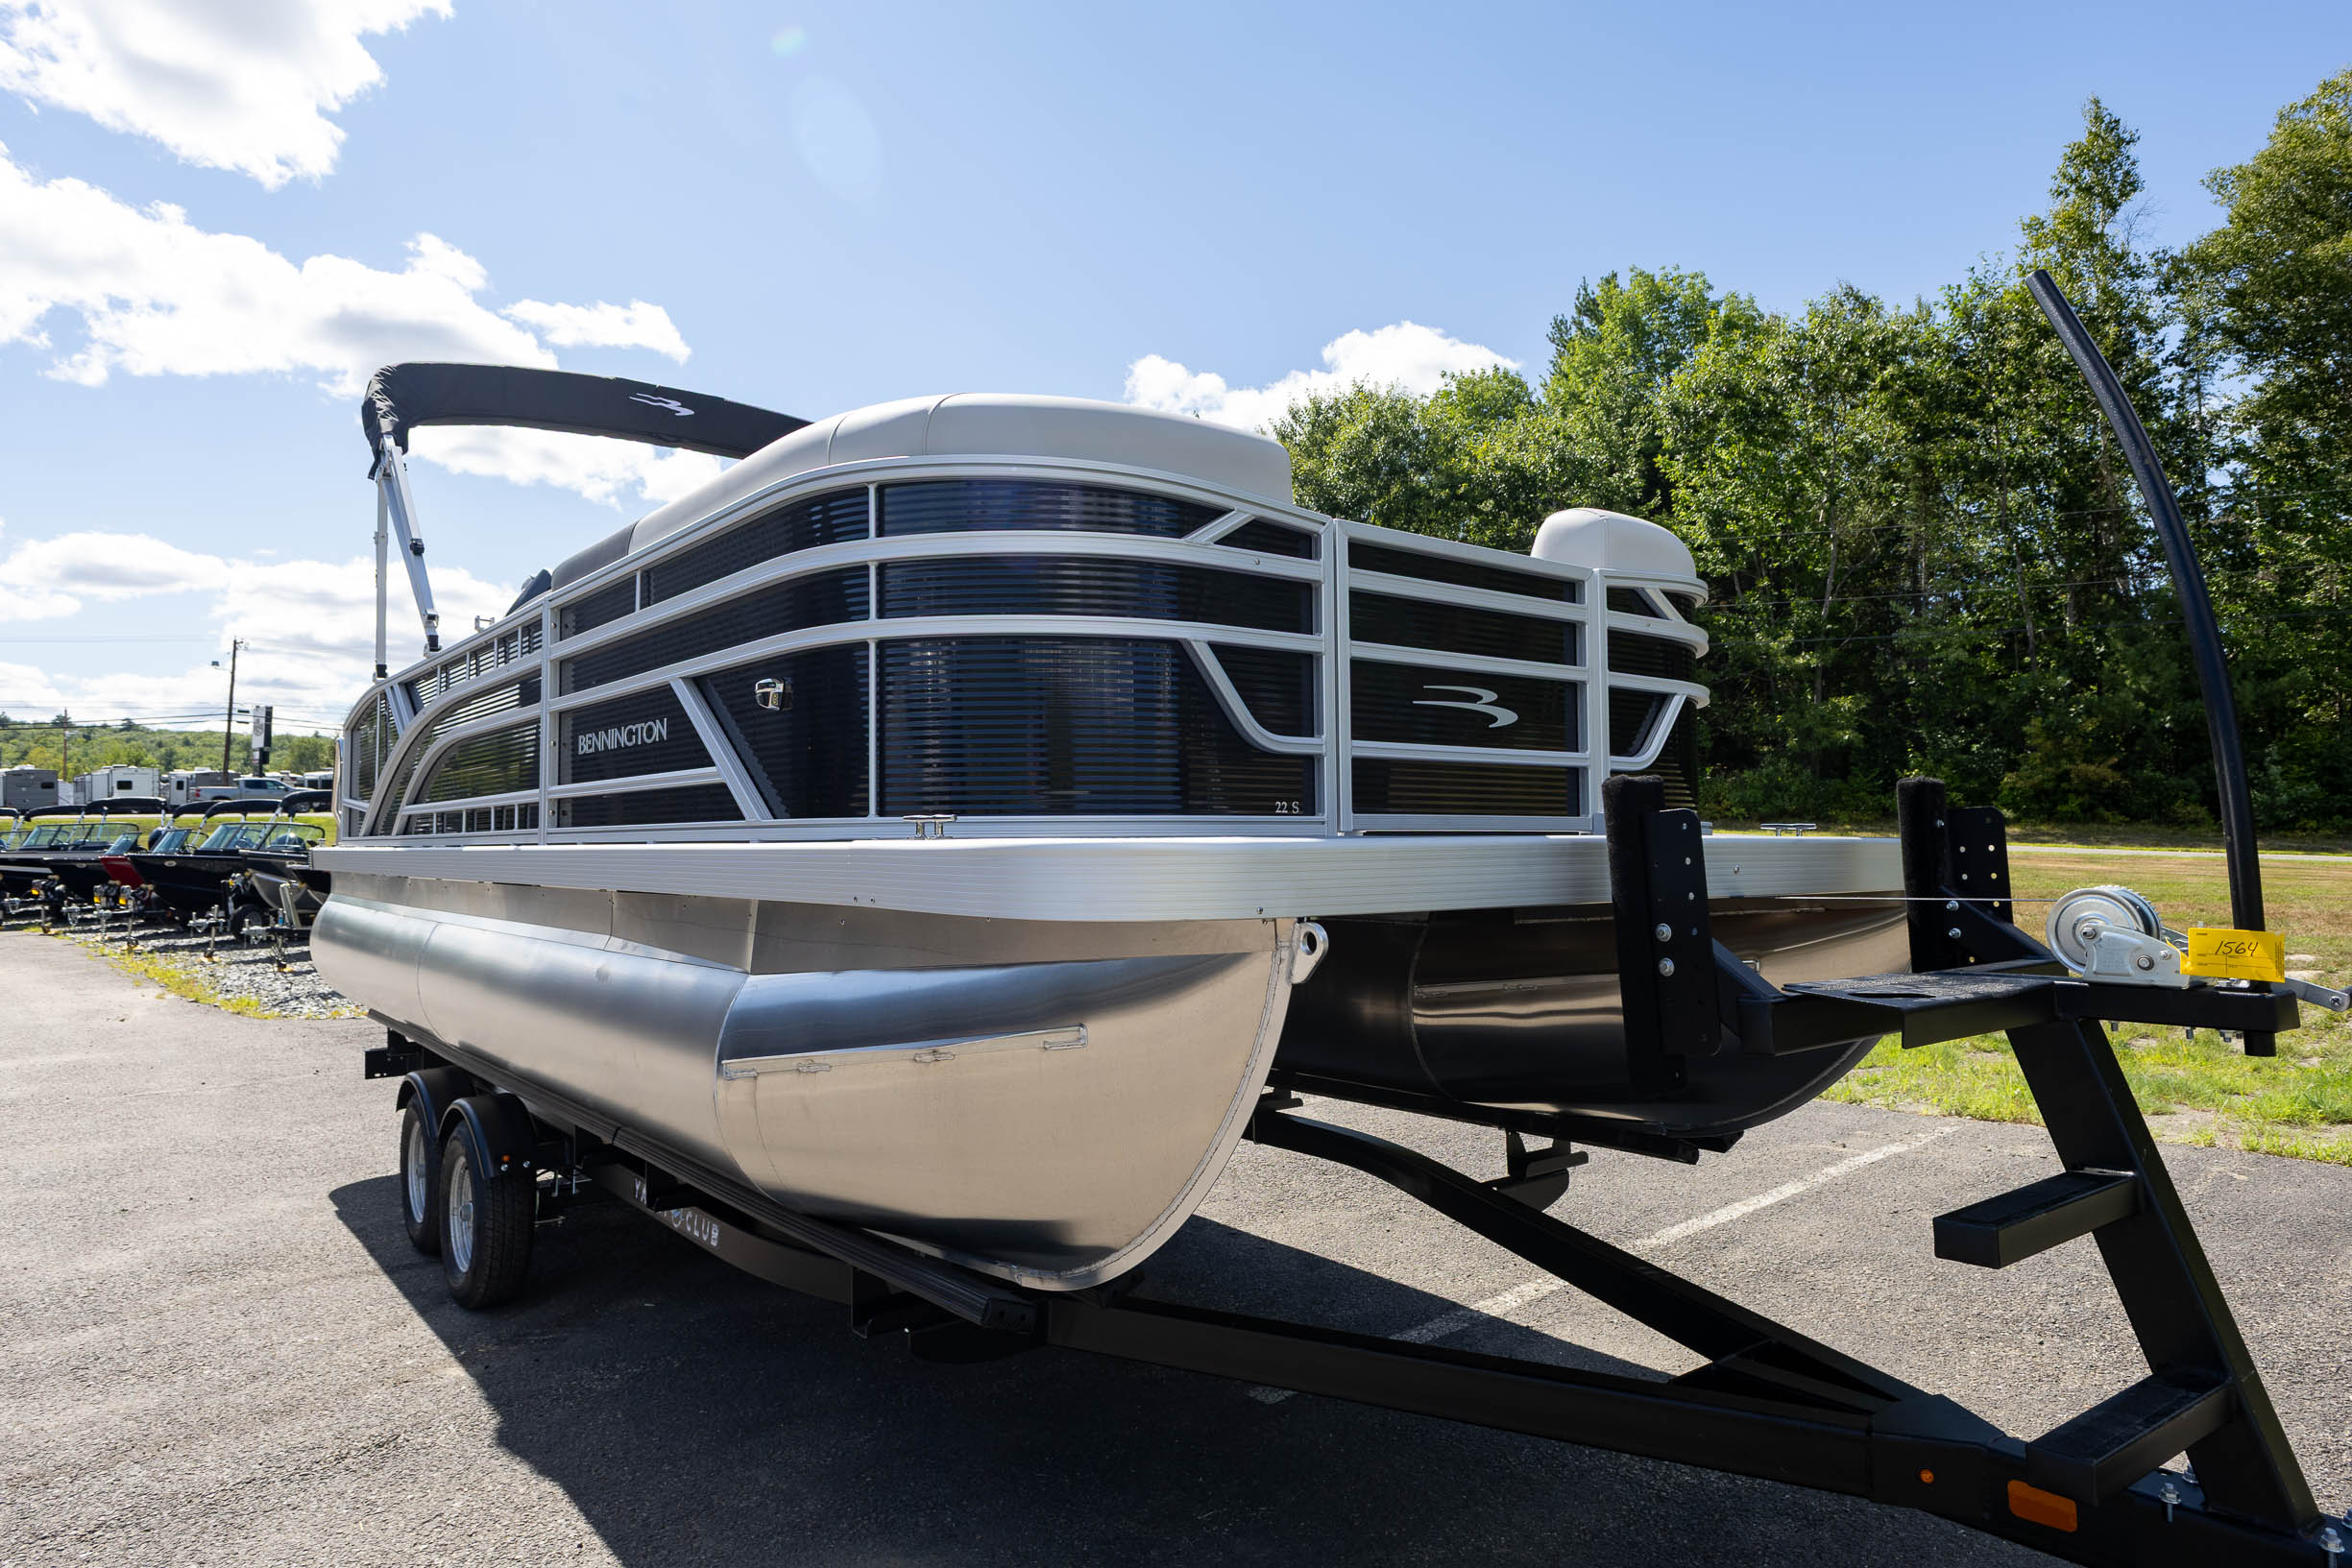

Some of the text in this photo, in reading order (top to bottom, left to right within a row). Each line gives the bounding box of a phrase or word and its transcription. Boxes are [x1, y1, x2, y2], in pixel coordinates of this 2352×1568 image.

[578, 717, 667, 755] BENNINGTON
[1274, 801, 1299, 814] 22 S
[2214, 940, 2259, 957] 1564
[686, 1211, 718, 1247] CLUB
